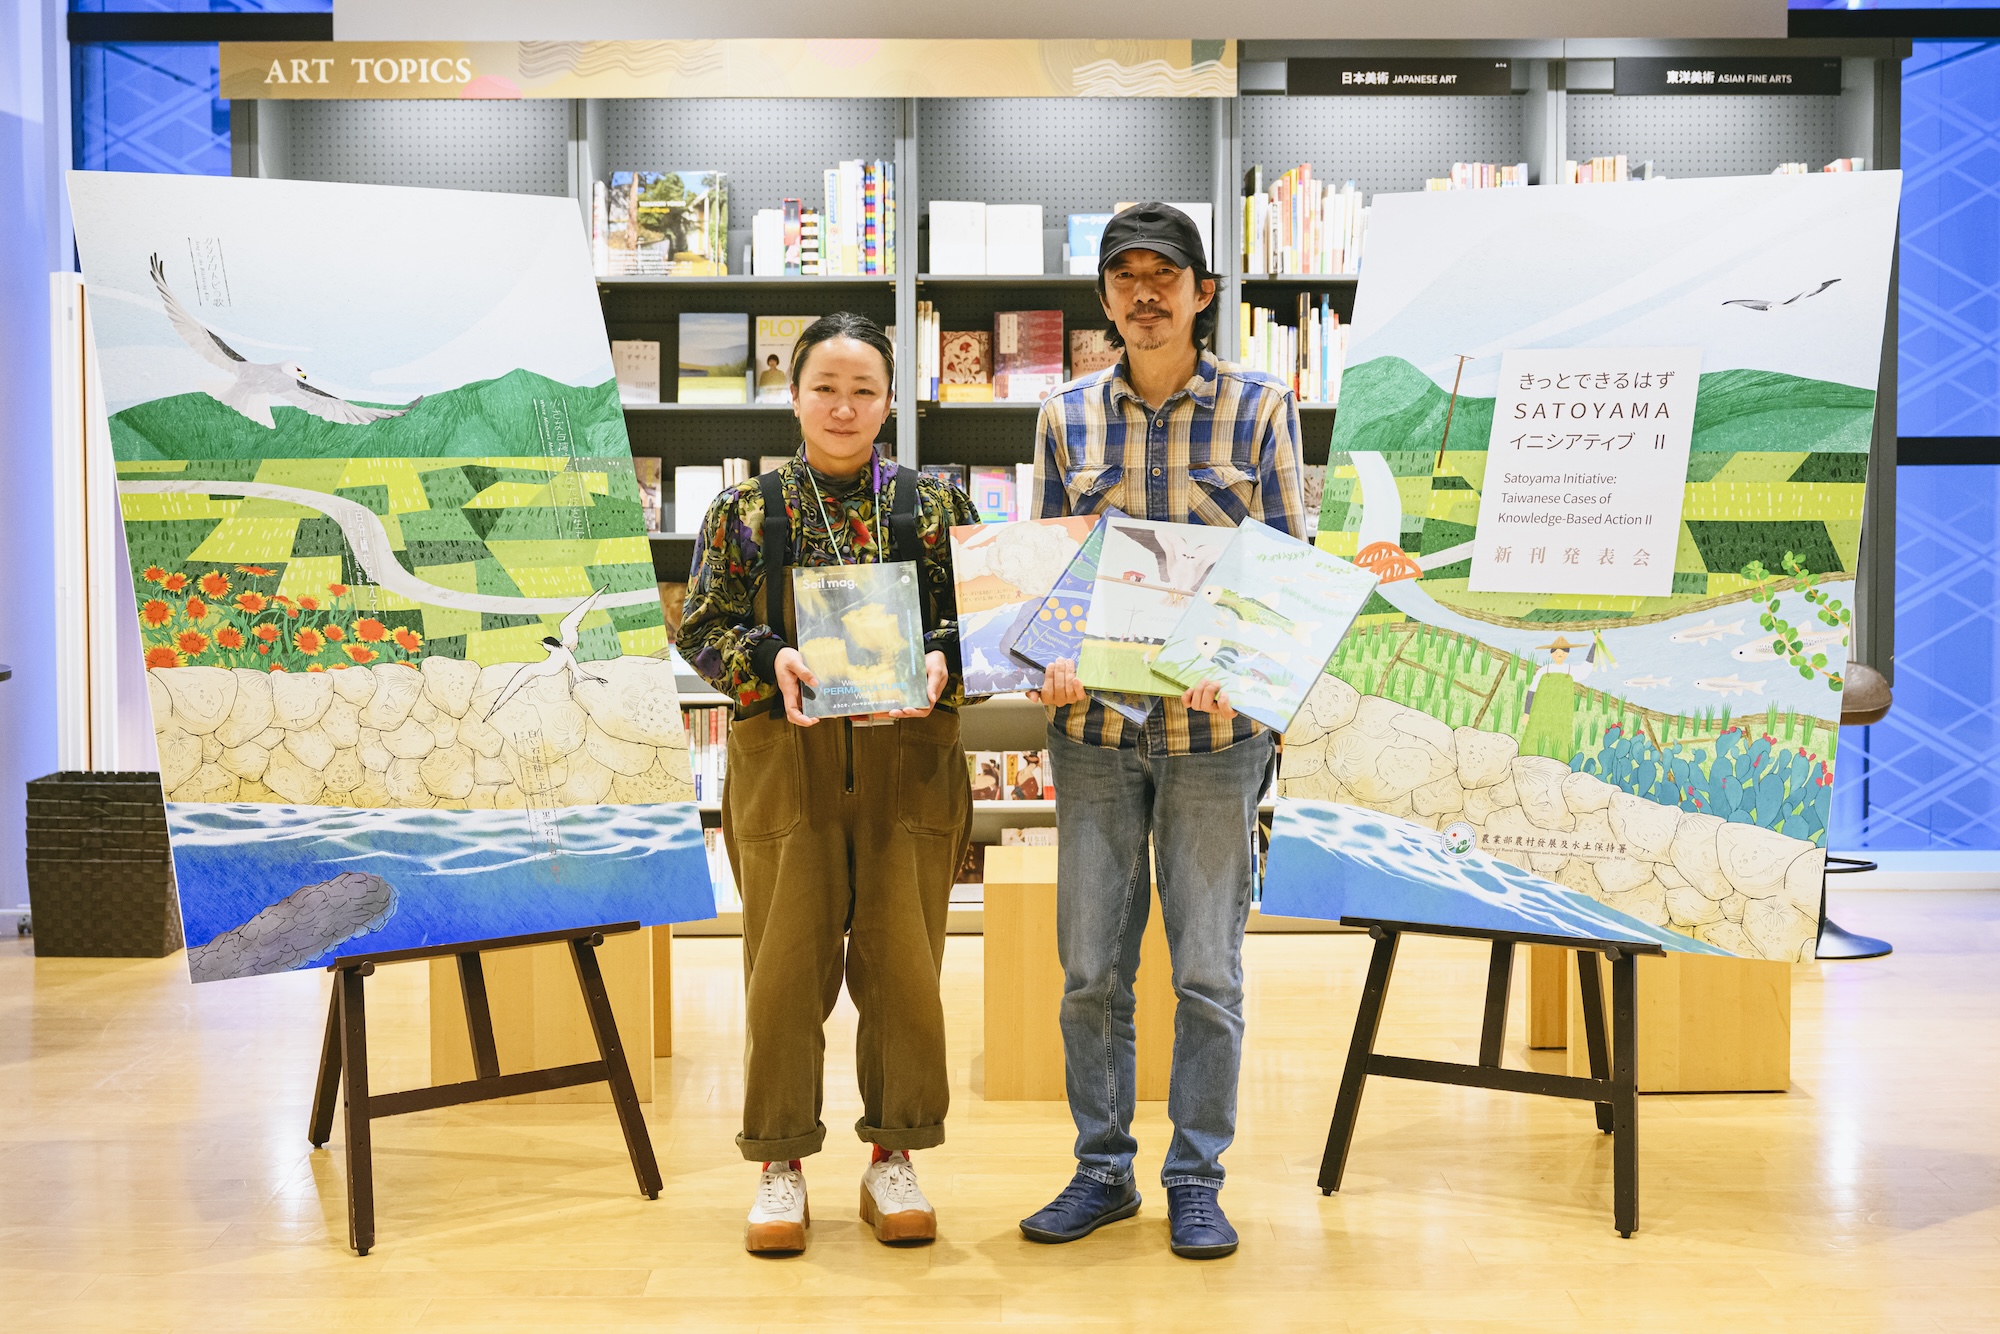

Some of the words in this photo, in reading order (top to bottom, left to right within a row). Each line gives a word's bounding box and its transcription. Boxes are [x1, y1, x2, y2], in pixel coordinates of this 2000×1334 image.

[264, 58, 334, 84] ART
[351, 58, 472, 84] TOPICS
[1341, 71, 1389, 85] 日本美術
[1392, 75, 1438, 84] JAPANESE
[1439, 75, 1458, 84] ART
[1666, 70, 1715, 84] 東洋美術
[1718, 74, 1745, 83] ASIAN
[1746, 74, 1768, 83] FINE
[1769, 74, 1793, 83] ARTS
[1519, 370, 1676, 390] きっとできるはず
[1514, 402, 1670, 420] SATOYAMA
[1510, 431, 1636, 451] イニシアティブ
[1504, 473, 1561, 487] Satoyama
[1563, 473, 1617, 485] Initiative:
[1501, 492, 1561, 504] Taiwanese
[1563, 493, 1597, 504] Cases
[1599, 493, 1613, 504] of
[1498, 513, 1602, 526] Knowledge-Based
[1604, 514, 1642, 525] Action
[1494, 545, 1651, 567] 新刊発表会
[802, 578, 825, 590] Soil
[827, 578, 859, 590] mag.
[823, 682, 908, 696] PERMACULTURE
[1481, 833, 1628, 854] 農業部農村發展及水土保持署
